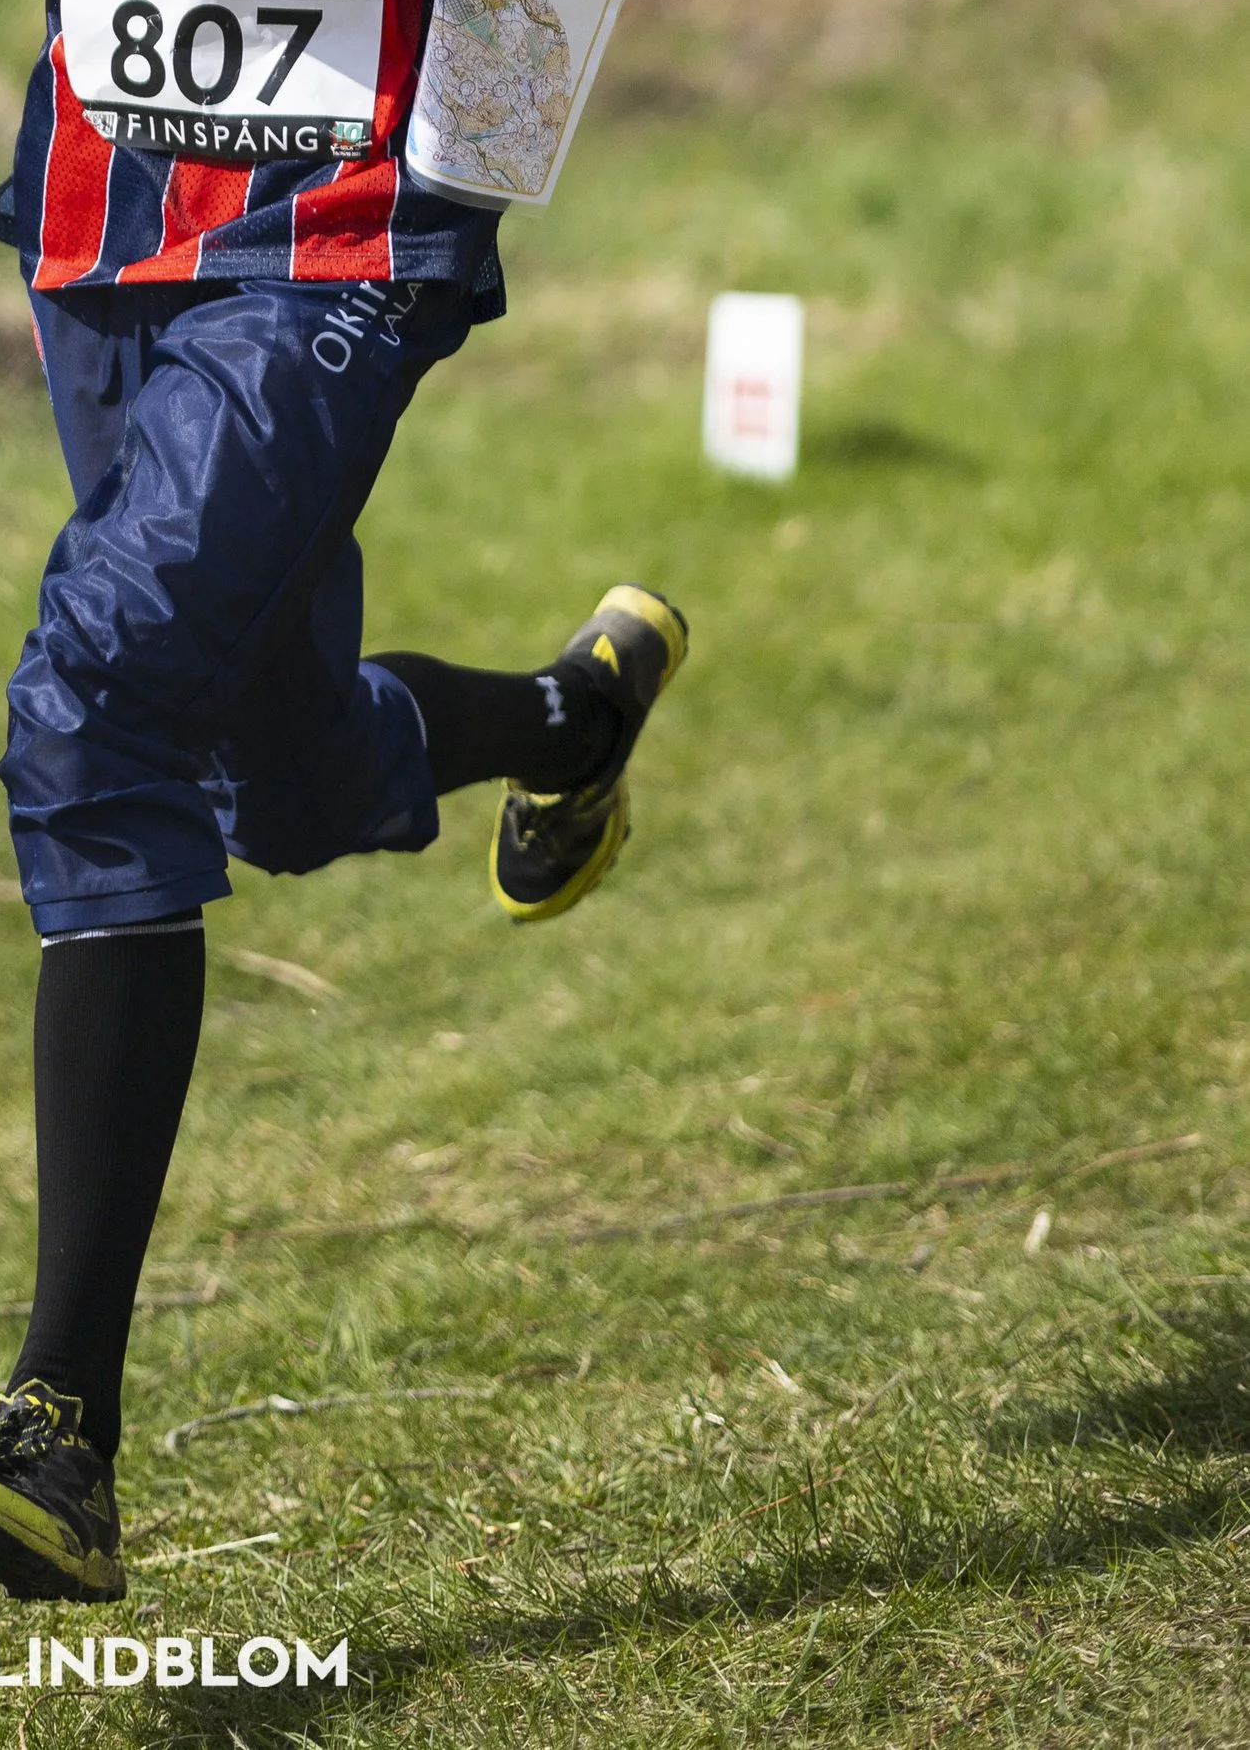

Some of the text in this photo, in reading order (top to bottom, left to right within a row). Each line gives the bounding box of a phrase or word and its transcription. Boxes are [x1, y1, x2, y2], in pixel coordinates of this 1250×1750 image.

[111, 0, 323, 106] 807
[127, 113, 318, 151] FINSPÅNG
[331, 122, 362, 143] 10
